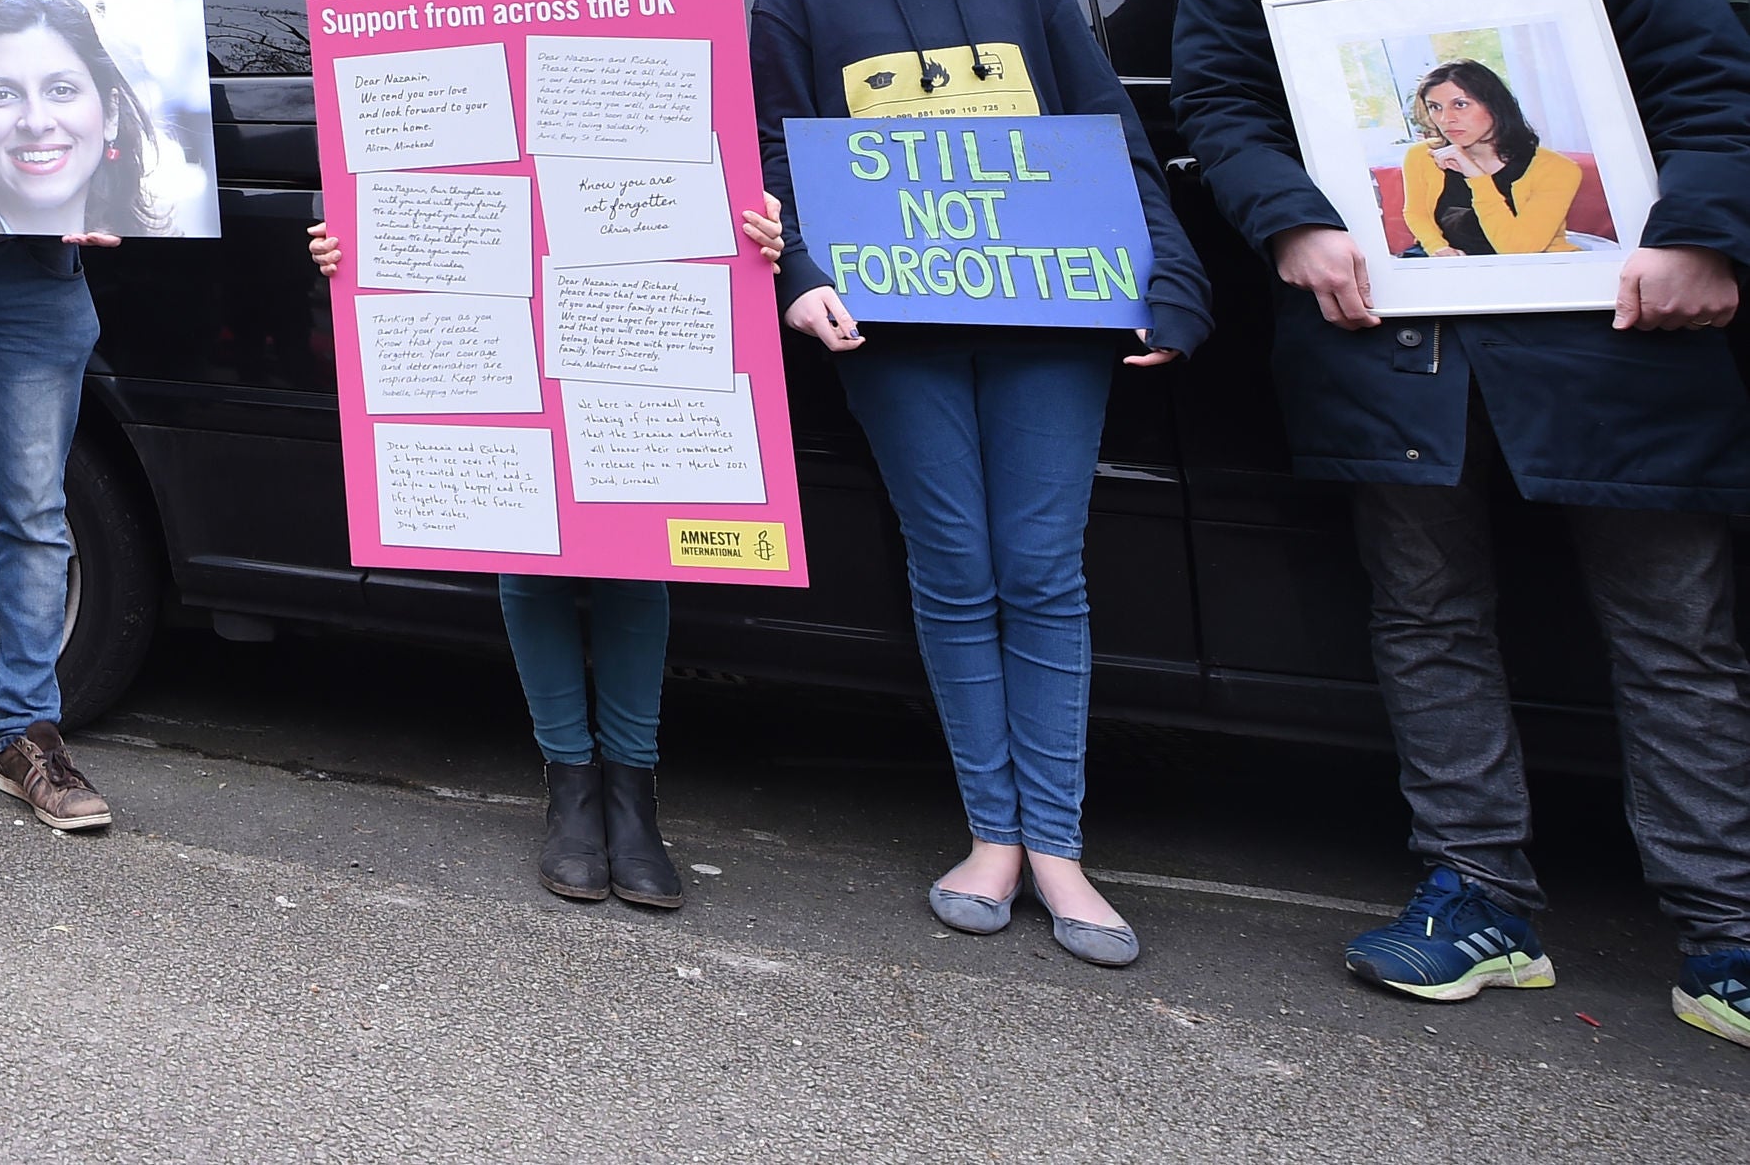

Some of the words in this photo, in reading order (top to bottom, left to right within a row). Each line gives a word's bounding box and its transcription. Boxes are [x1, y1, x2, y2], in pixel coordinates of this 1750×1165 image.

[321, 5, 419, 38] Support
[424, 1, 485, 28] from
[355, 76, 380, 88] Dear
[361, 92, 376, 103] We
[381, 89, 404, 101] send
[406, 92, 424, 102] you
[448, 86, 467, 95] love
[359, 108, 379, 119] and
[382, 107, 402, 118] look
[405, 102, 447, 117] forward
[451, 103, 461, 112] to
[465, 103, 488, 114] your
[365, 127, 398, 135] return
[847, 130, 1051, 182] STILL
[620, 180, 646, 196] you
[649, 176, 676, 185] are
[584, 198, 608, 212] not
[609, 193, 677, 220] forgotten
[898, 189, 1006, 240] NOT
[829, 243, 1139, 301] FORGOTTEN
[557, 275, 579, 285] Dear
[582, 278, 618, 287] Nazanin
[560, 287, 585, 298] please
[588, 288, 611, 297] know
[614, 290, 634, 299] that
[669, 293, 706, 306] thinking
[558, 299, 568, 307] of
[569, 302, 583, 310] you
[586, 301, 604, 309] and
[606, 305, 624, 313] your
[627, 302, 654, 315] family
[671, 305, 688, 314] this
[420, 313, 431, 322] of
[434, 315, 451, 325] you
[474, 315, 491, 324] you
[562, 312, 574, 320] We
[618, 315, 642, 326] hopes
[645, 316, 658, 325] for
[660, 321, 680, 329] your
[684, 319, 714, 329] release
[413, 328, 435, 339] your
[559, 322, 576, 330] and
[579, 323, 598, 332] that
[602, 327, 615, 335] you
[618, 325, 633, 334] will
[659, 325, 669, 336] be
[672, 329, 698, 338] where
[700, 333, 715, 341] you
[409, 337, 431, 346] that
[436, 340, 452, 350] you
[484, 336, 500, 344] not
[593, 346, 616, 356] Yours
[594, 335, 614, 345] back
[617, 338, 640, 346] home
[644, 340, 662, 348] with
[667, 343, 685, 351] your
[689, 342, 713, 354] loving
[457, 350, 497, 360] courage
[381, 363, 401, 371] and
[406, 362, 477, 370] determination
[482, 374, 512, 384] strong
[630, 412, 638, 423] of
[666, 412, 684, 422] and
[601, 460, 636, 468] release
[681, 530, 740, 546] AMNESTY
[681, 546, 743, 558] INTERNATIONAL
